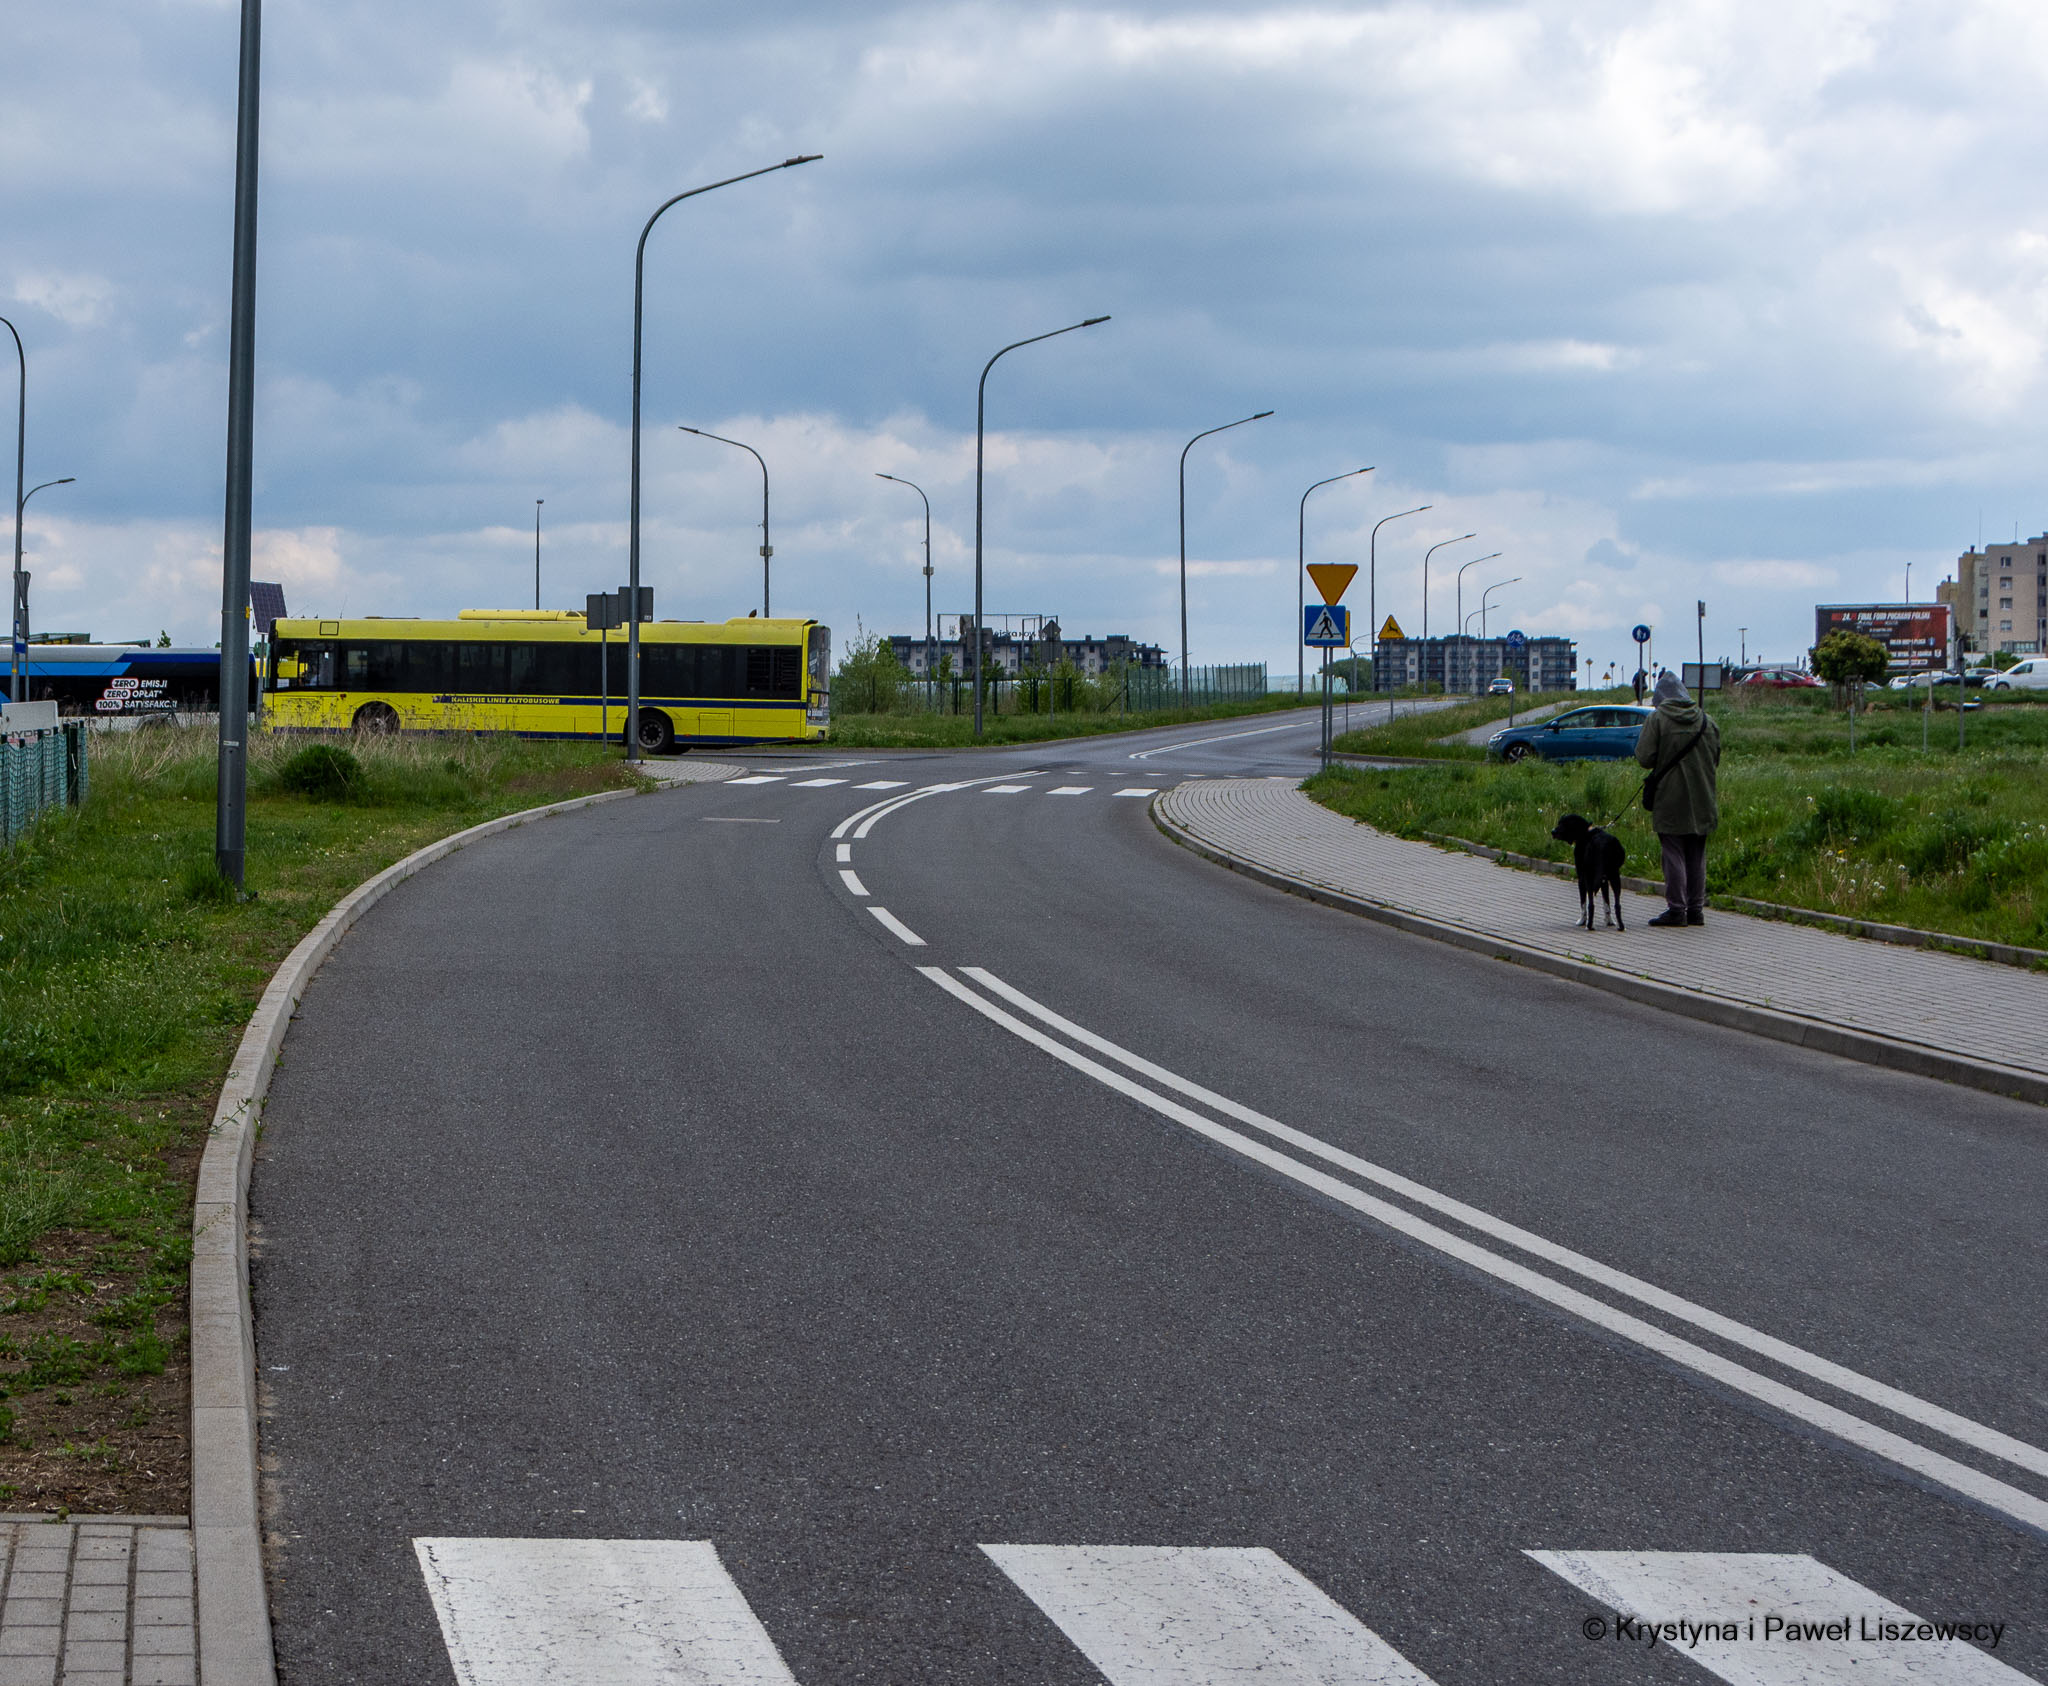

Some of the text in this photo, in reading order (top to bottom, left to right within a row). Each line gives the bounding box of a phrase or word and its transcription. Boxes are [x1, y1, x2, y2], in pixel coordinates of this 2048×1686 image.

[114, 679, 168, 688] ZERO EMISJI
[106, 690, 129, 698] ZERO
[99, 701, 120, 709] 100%
